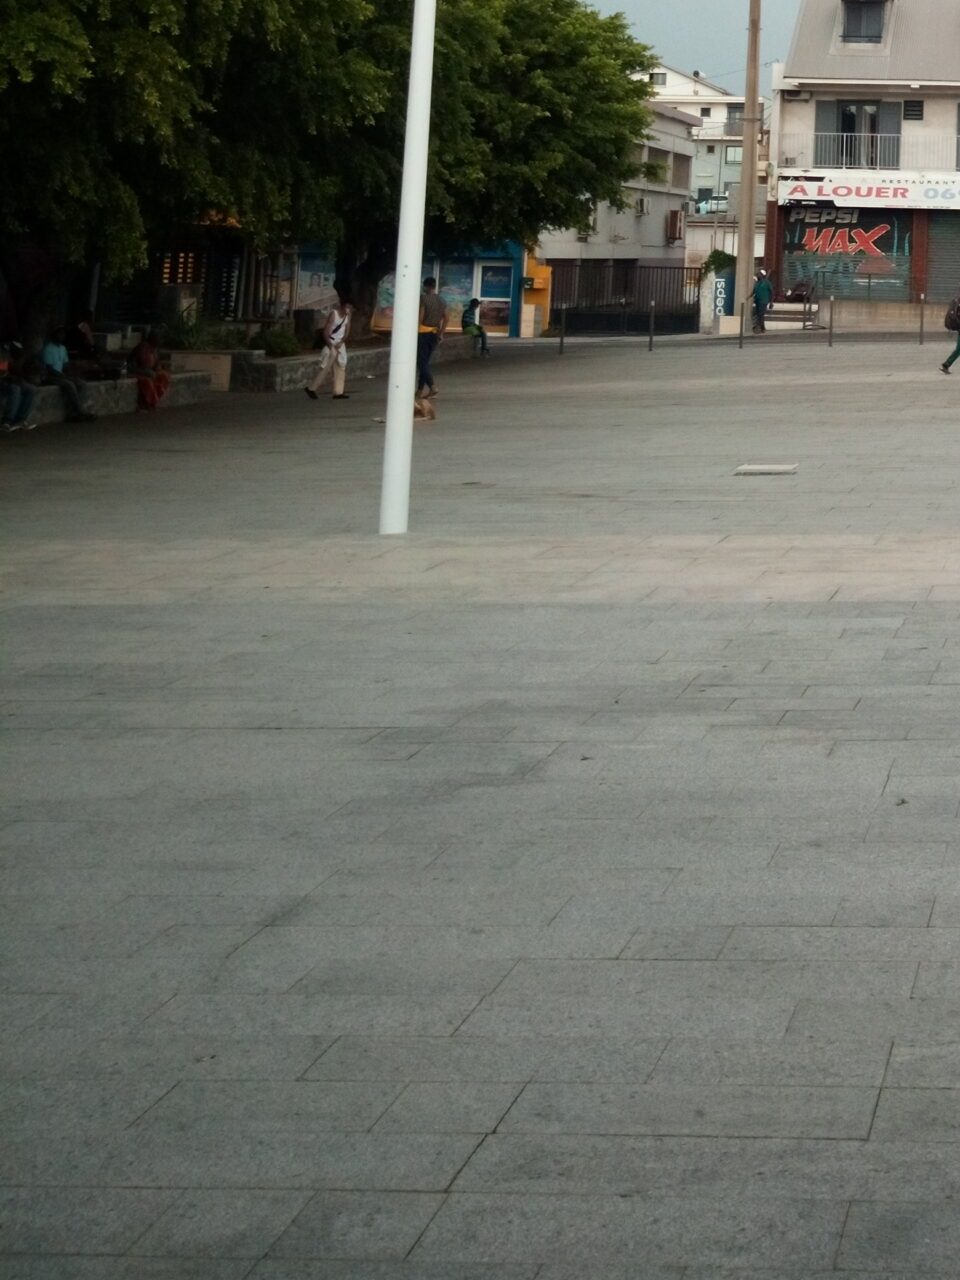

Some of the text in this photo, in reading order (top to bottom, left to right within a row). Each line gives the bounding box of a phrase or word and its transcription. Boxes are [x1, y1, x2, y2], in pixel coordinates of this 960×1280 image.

[788, 184, 809, 196] A
[816, 185, 910, 199] LOUER
[789, 208, 860, 224] PEPSI
[801, 224, 891, 257] MAX
[715, 278, 727, 316] pepsi
